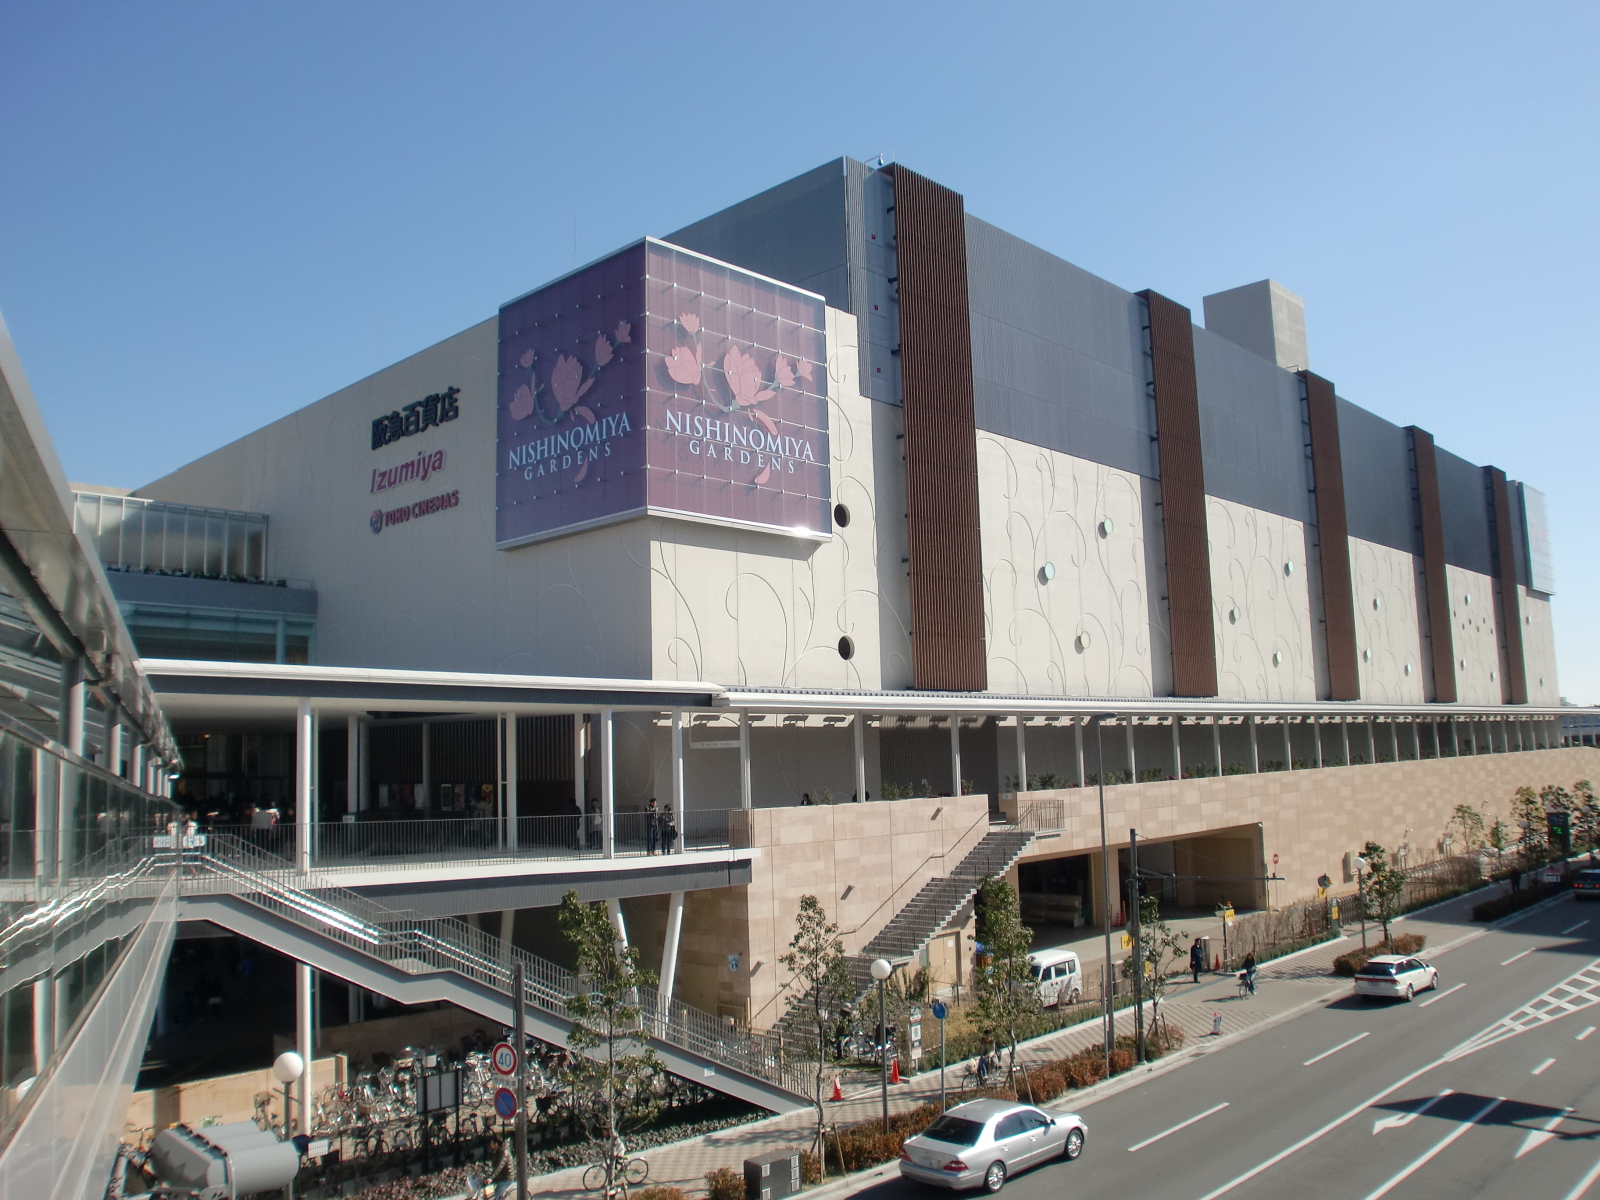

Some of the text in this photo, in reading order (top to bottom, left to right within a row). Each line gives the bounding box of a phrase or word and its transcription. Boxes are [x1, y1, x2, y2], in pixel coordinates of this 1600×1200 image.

[371, 386, 460, 450] 阪急百貨店
[665, 409, 815, 462] NISHINOMIYA
[508, 411, 632, 469] NISHINOMIYA
[689, 440, 794, 474] GARDENS
[370, 449, 444, 493] Izumiya
[524, 442, 611, 480] GARDENS
[382, 489, 459, 527] TOHO CINEMAS
[498, 1052, 512, 1068] 40
